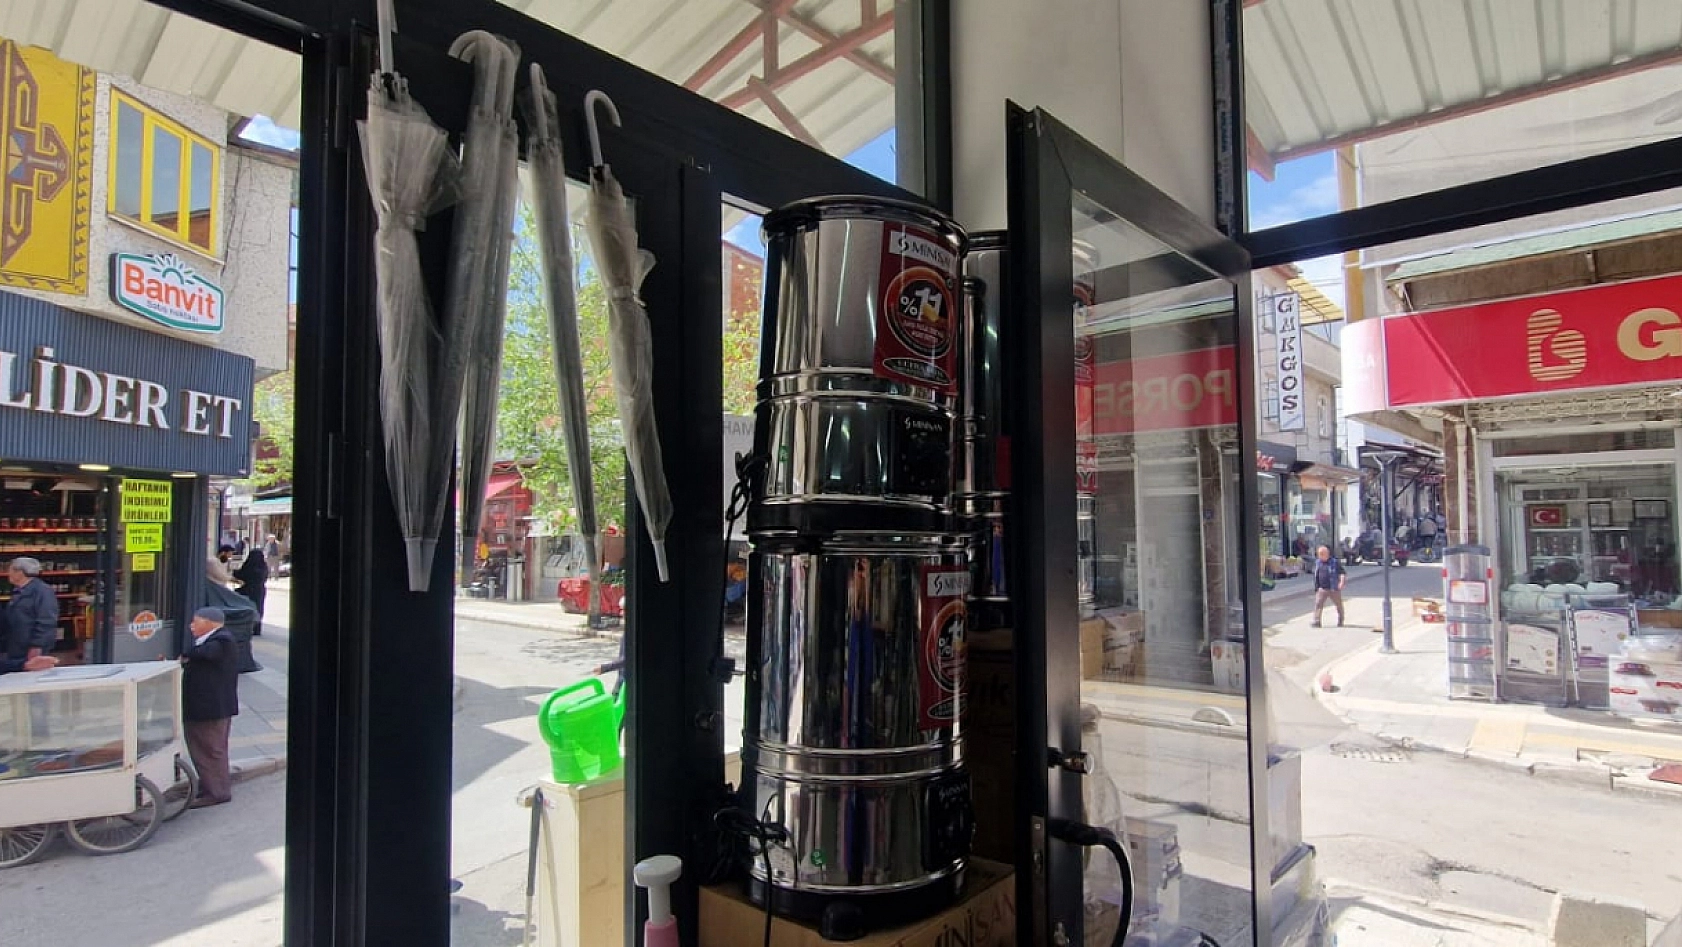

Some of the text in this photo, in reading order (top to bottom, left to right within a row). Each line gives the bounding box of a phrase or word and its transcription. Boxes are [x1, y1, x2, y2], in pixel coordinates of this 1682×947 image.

[125, 263, 215, 319] Banvit
[0, 347, 242, 437] LİDER ET
